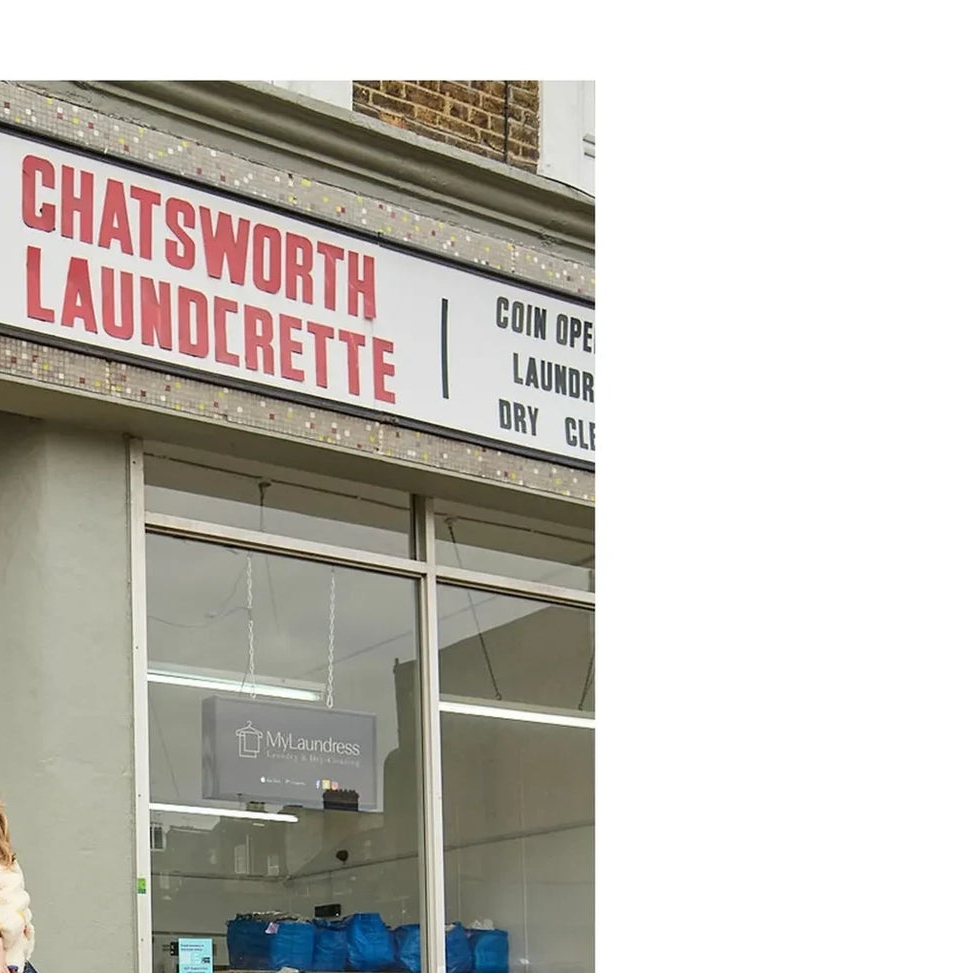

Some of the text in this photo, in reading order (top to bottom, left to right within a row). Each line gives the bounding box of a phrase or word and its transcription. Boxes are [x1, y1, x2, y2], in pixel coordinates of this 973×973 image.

[21, 155, 376, 321] CHATSWORTH
[496, 296, 596, 354] COIN OPE
[498, 398, 539, 436] DRY
[266, 730, 361, 757] MyLaundress
